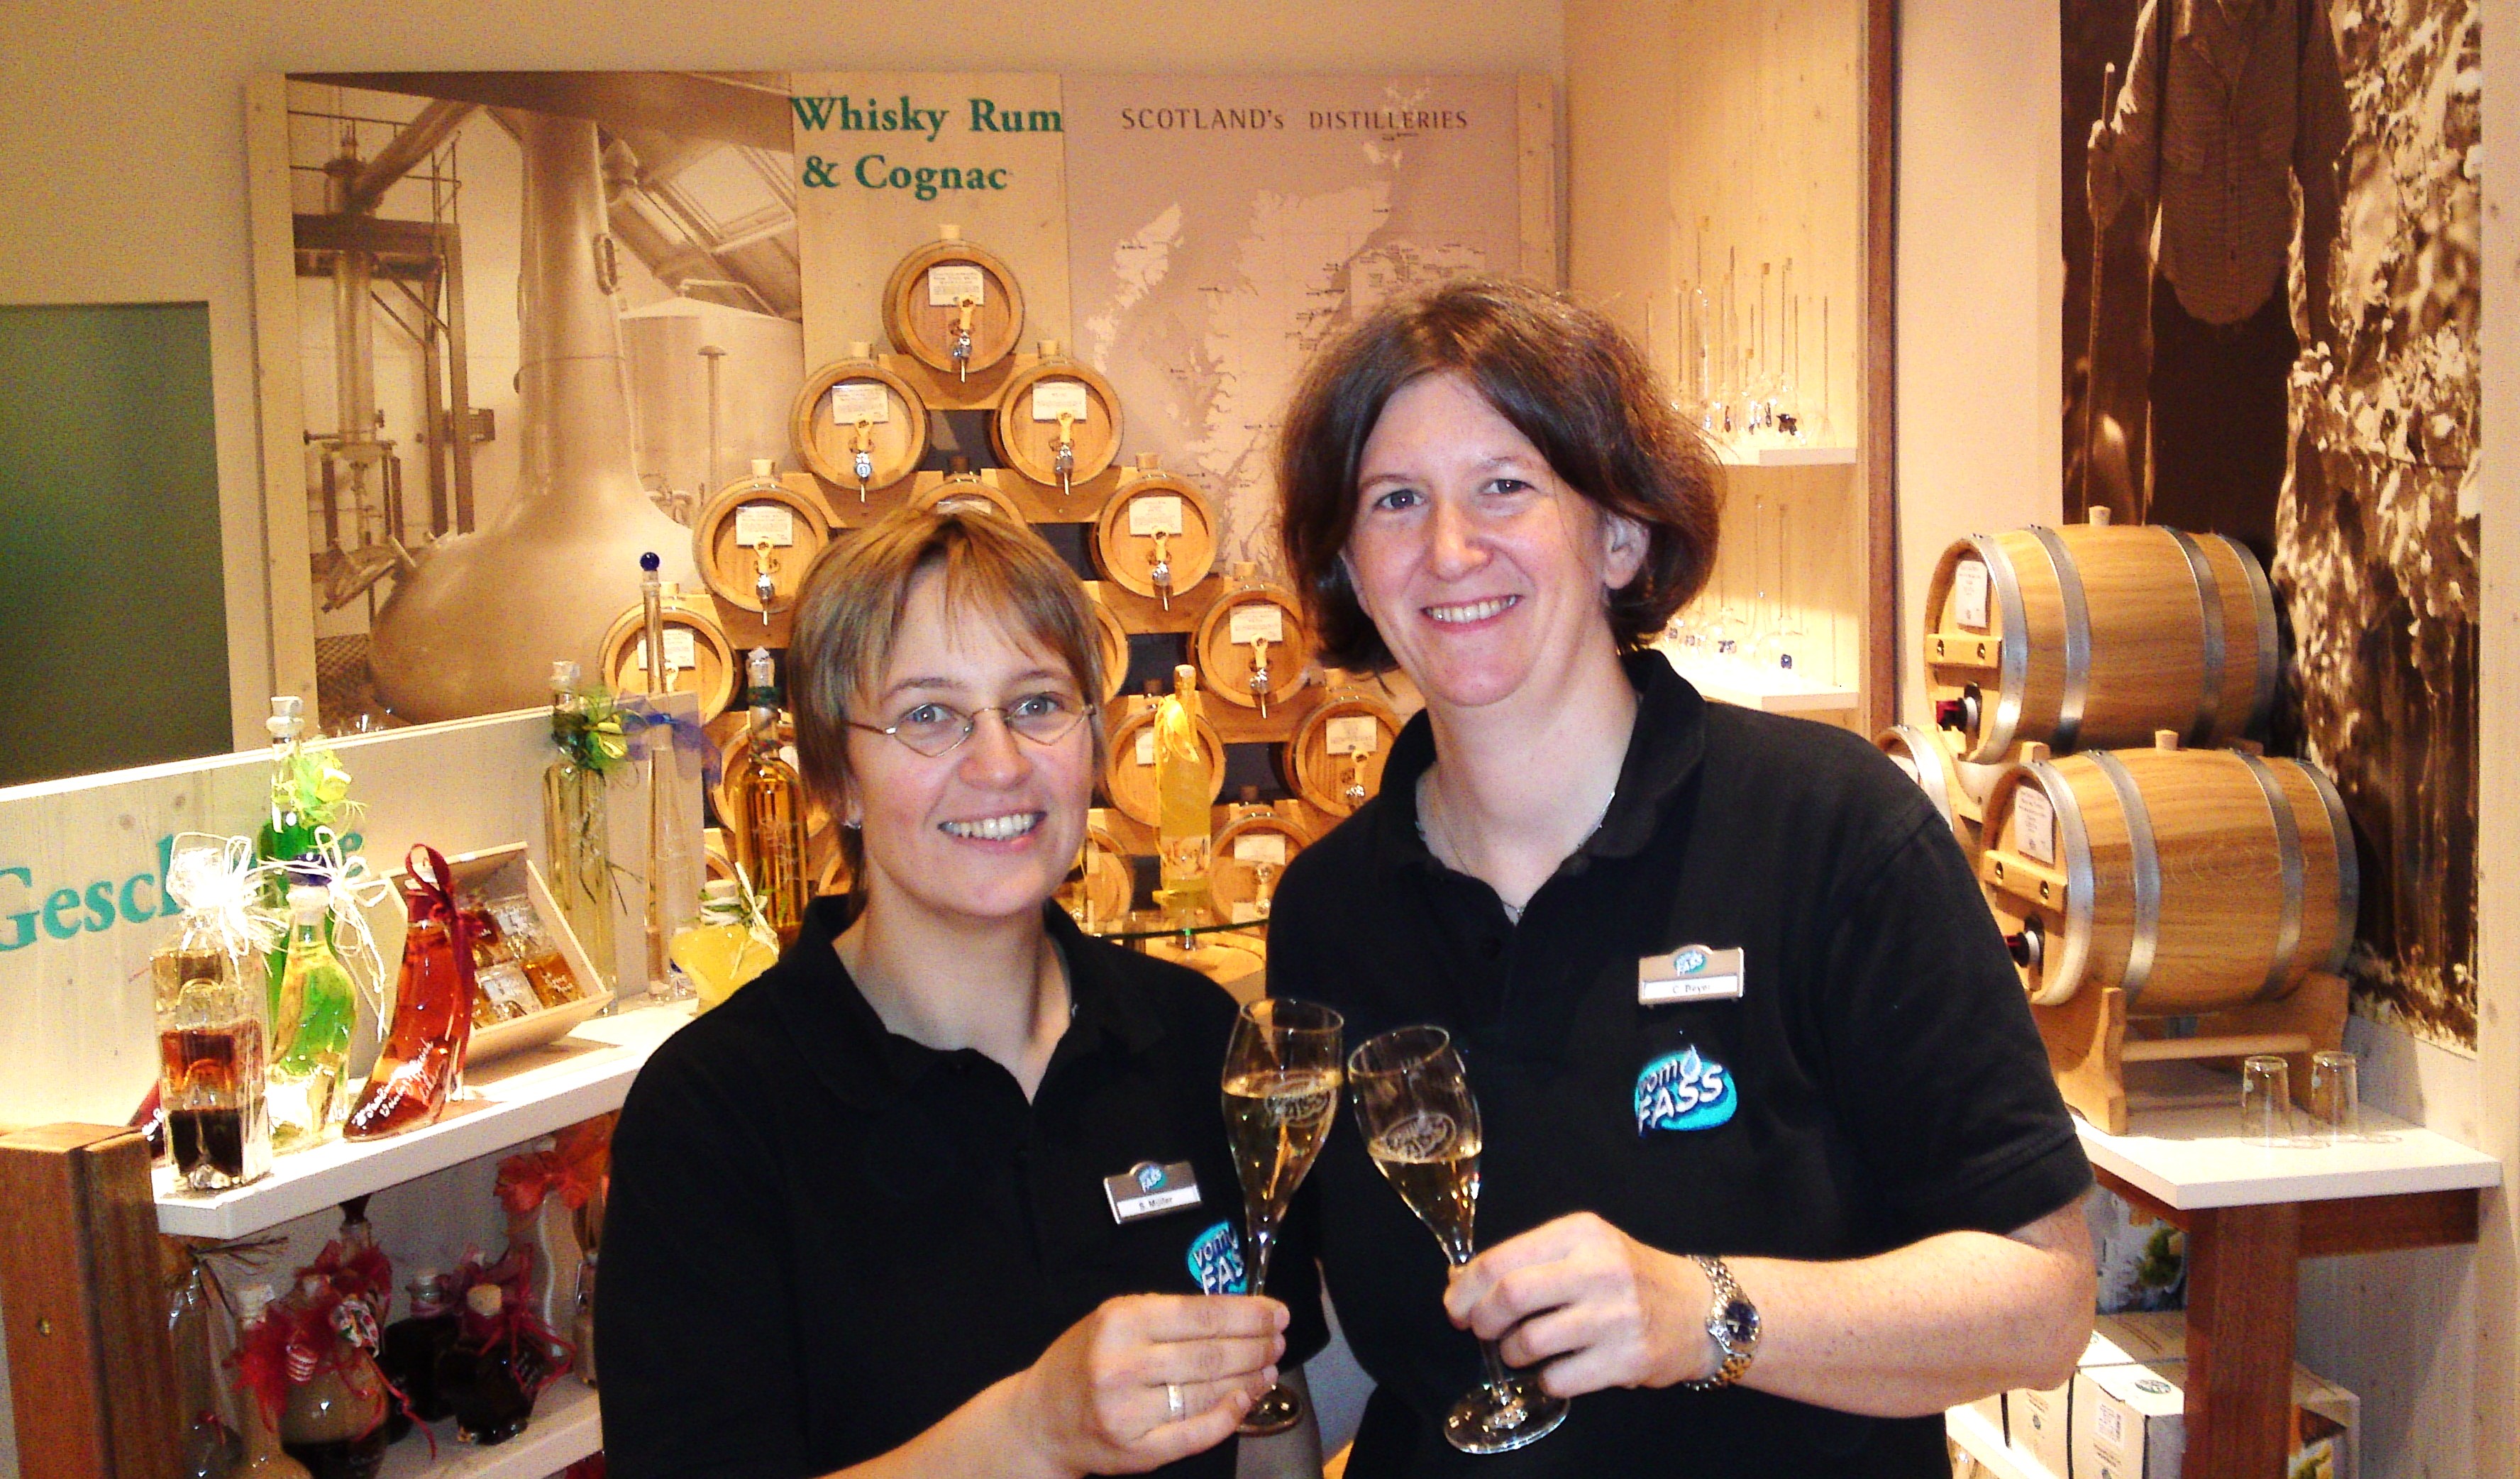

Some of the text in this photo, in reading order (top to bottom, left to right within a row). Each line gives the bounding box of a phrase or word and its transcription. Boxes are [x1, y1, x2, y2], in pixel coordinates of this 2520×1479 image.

[791, 94, 1064, 142] Whisky Rum
[1121, 108, 1467, 130] SCOTLAND's DISTILLERIES
[802, 154, 1008, 201] & Cognac
[1638, 1063, 1724, 1136] FASS
